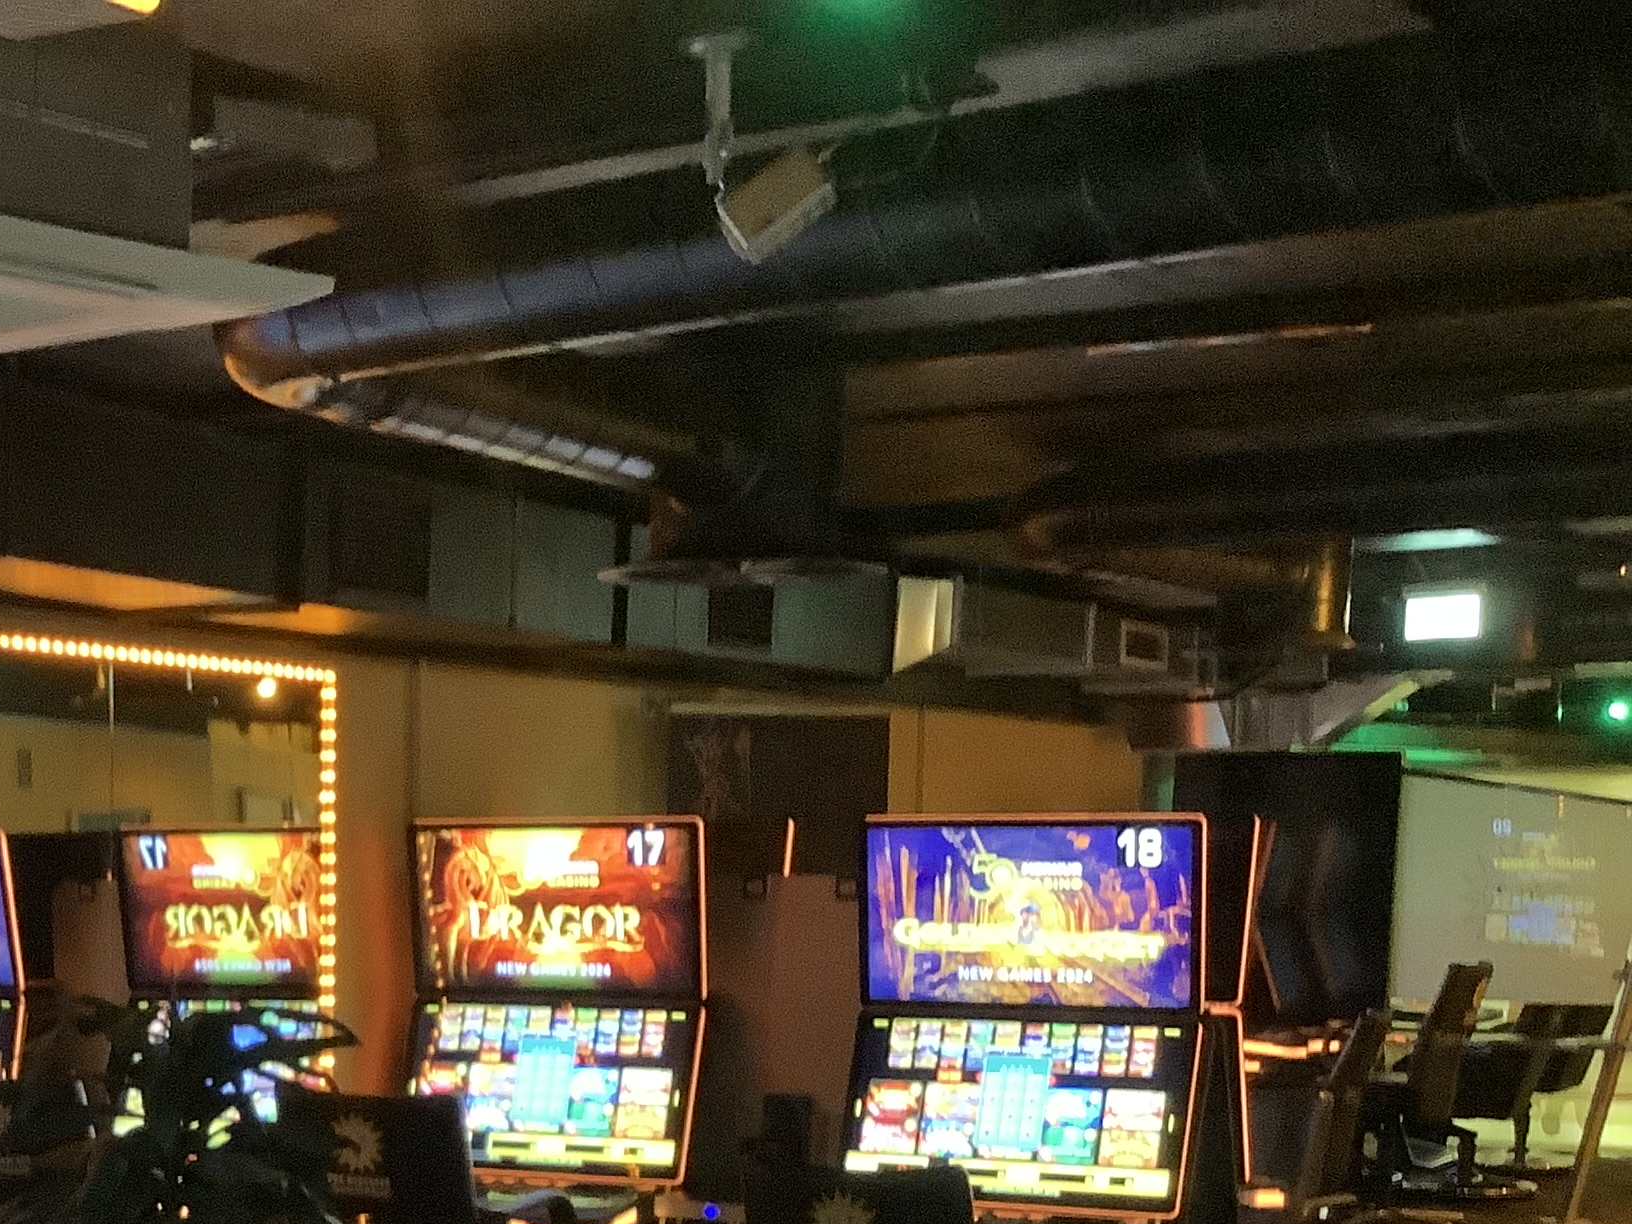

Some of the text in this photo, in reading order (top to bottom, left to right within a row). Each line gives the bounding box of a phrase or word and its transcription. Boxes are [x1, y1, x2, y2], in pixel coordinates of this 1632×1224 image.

[627, 829, 665, 867] 17
[1117, 827, 1163, 869] 18
[957, 965, 994, 983] NEW
